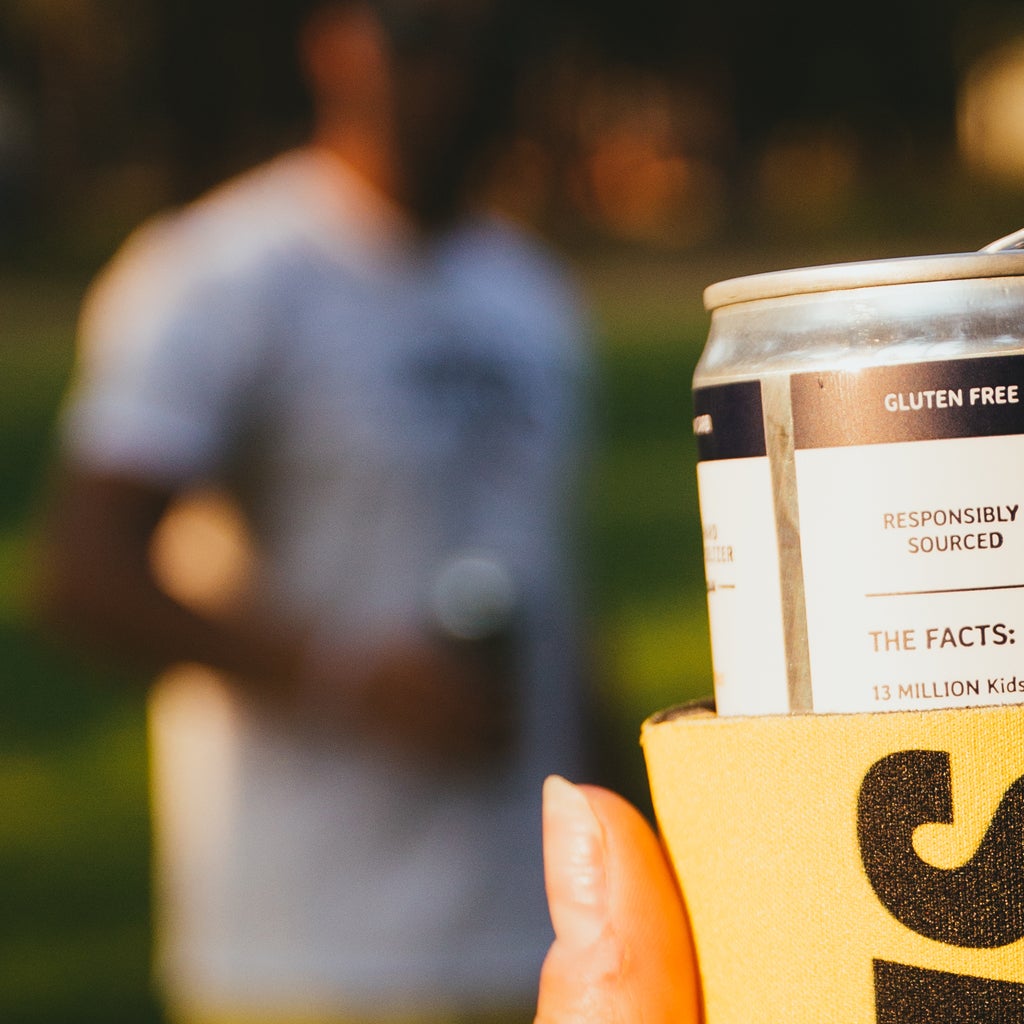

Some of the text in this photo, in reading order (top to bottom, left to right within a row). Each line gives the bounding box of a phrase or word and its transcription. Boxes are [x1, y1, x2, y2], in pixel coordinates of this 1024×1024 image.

[884, 385, 1020, 413] GLUTEN FREE
[883, 504, 1019, 530] RESPONSIBLY
[907, 532, 1004, 554] SOURCED
[868, 623, 1017, 653] THE FACTS:
[872, 684, 893, 702] 13
[898, 678, 979, 701] MILLION
